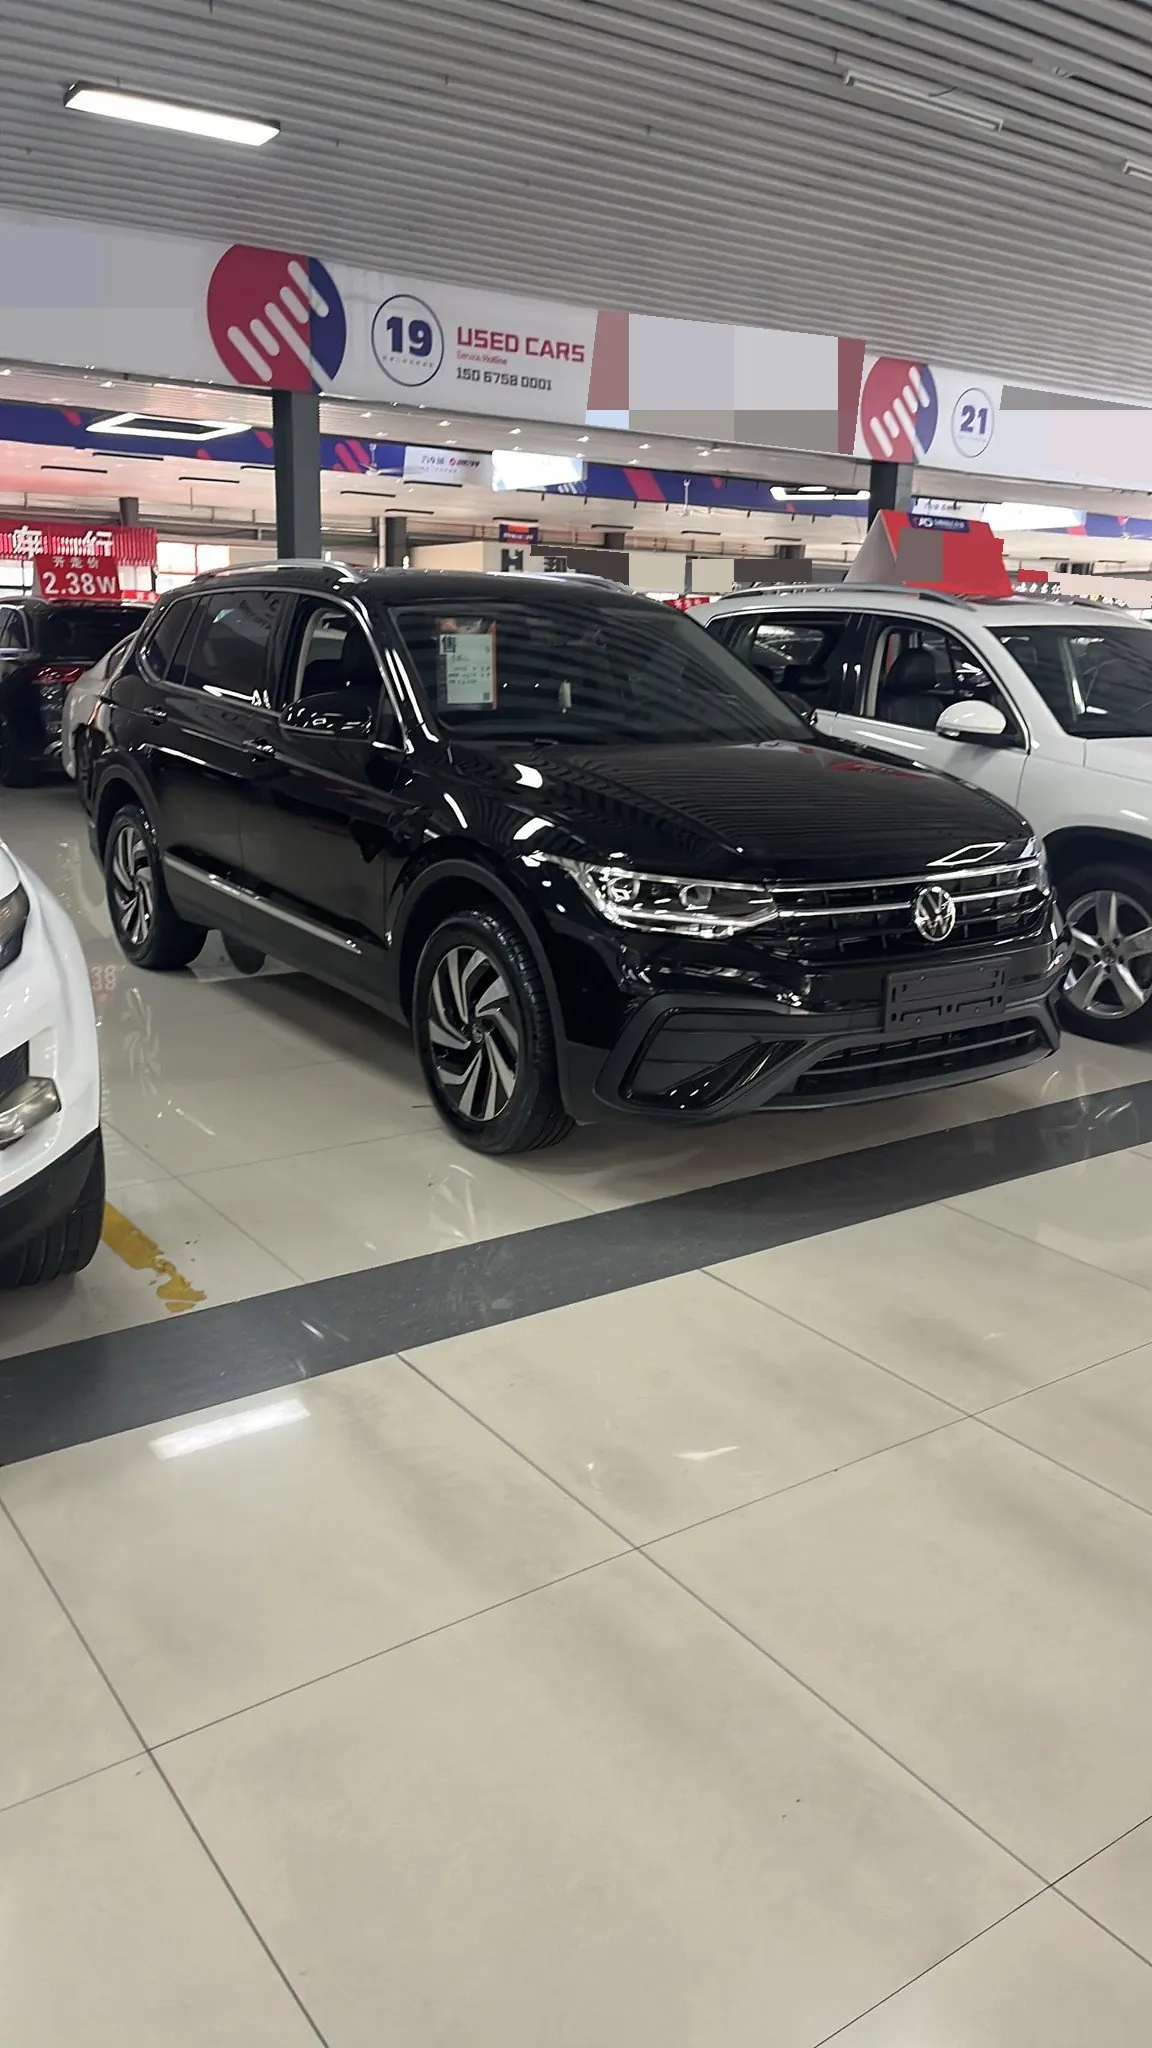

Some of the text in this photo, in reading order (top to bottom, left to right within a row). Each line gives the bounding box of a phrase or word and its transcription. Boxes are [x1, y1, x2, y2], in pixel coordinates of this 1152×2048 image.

[387, 316, 433, 358] 19
[457, 326, 585, 363] USED CARS
[456, 367, 552, 391] 150 6758 0001
[959, 405, 988, 435] 21
